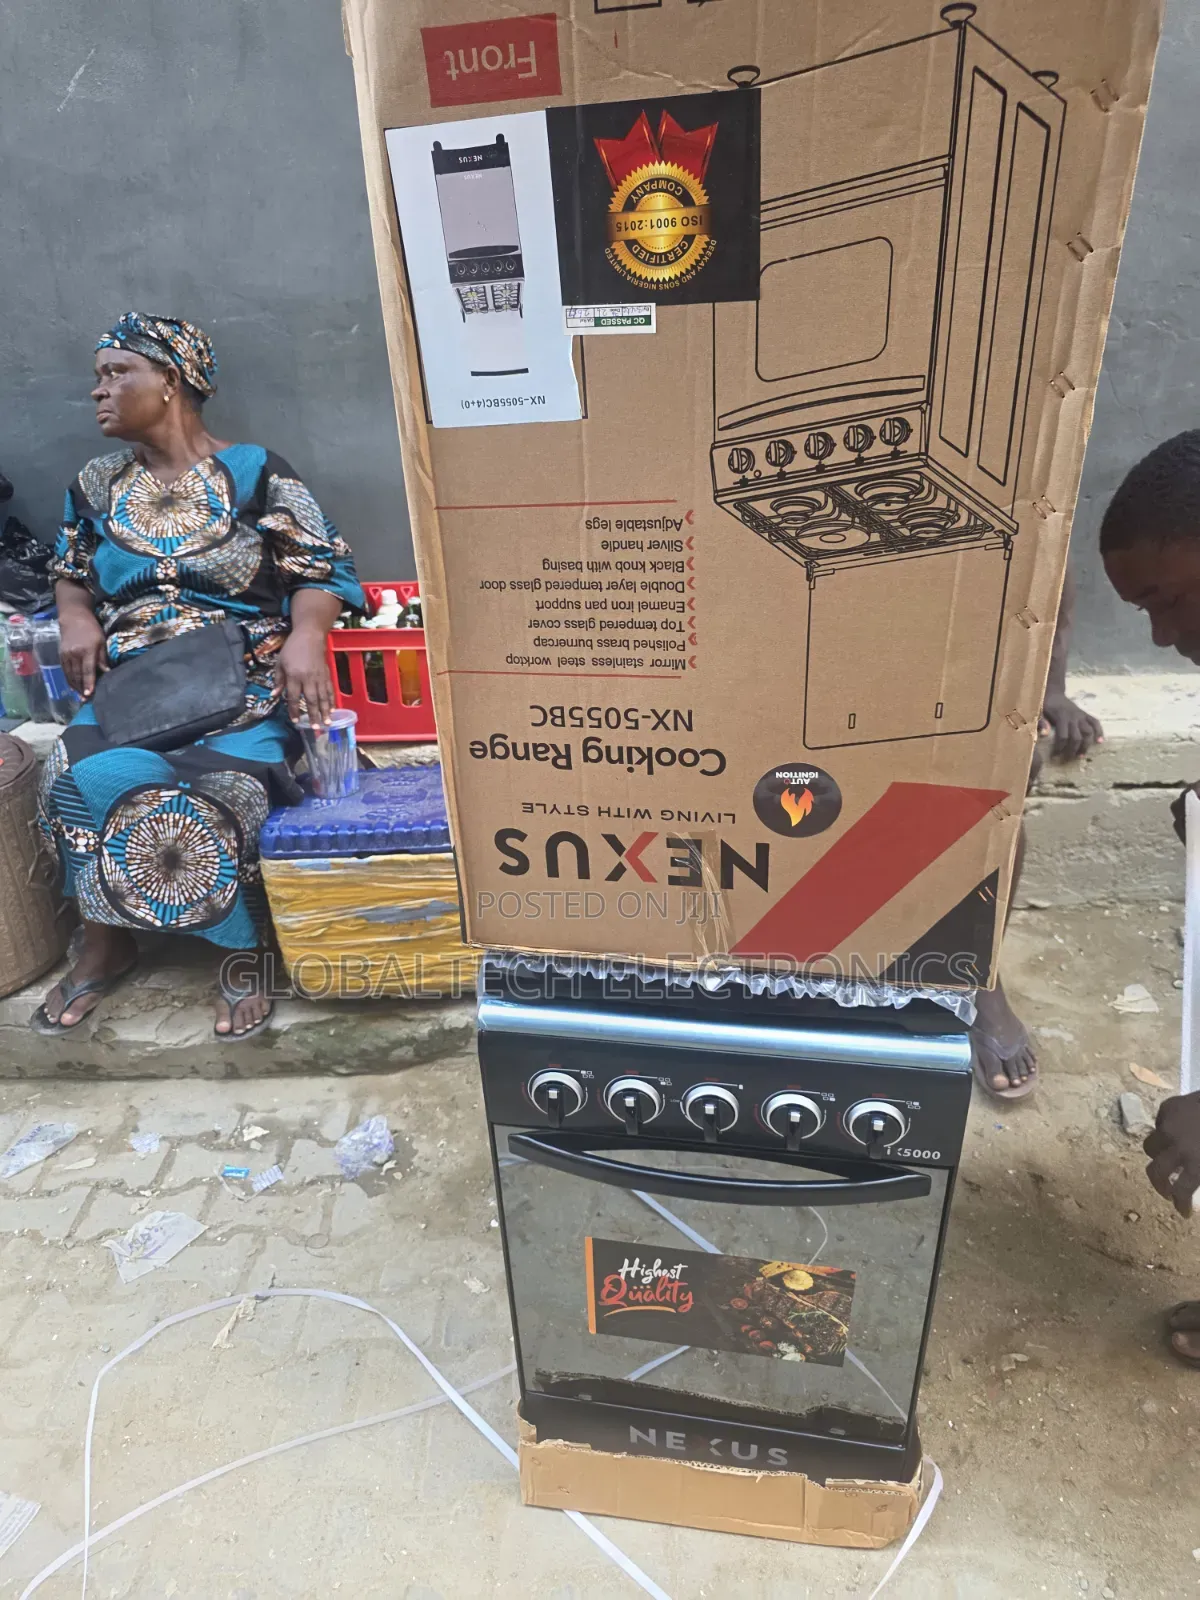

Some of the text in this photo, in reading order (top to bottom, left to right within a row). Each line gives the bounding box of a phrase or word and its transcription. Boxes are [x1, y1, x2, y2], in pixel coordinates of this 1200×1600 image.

[444, 41, 538, 80] Front
[458, 155, 483, 163] NEXUS
[630, 180, 683, 203] COMPANY
[615, 215, 703, 232] ISO 9001:2015
[631, 240, 689, 264] CERTIFIED
[604, 239, 717, 290] DEEKAY AND SONS NIGERIA LIMITED
[585, 517, 683, 531] Adjustable legs
[601, 540, 683, 551] Silver handle
[542, 558, 684, 572] Black knob with basing
[480, 579, 684, 593] Double layer tempered glass door
[536, 599, 685, 613] Enamel iron pan support
[528, 618, 685, 632] Top tempered glass cover
[533, 635, 686, 651] Polished brass burnercap
[506, 653, 686, 670] Mirror stainless steel worktop
[529, 704, 694, 731] NX-5055BC
[469, 733, 727, 776] Cooking Range
[521, 802, 736, 824] LIVING WITH STYLE
[493, 827, 770, 893] NEXUS
[618, 1257, 688, 1284] Highest
[598, 1274, 694, 1313] Quality
[629, 1425, 788, 1466] NEXUS
